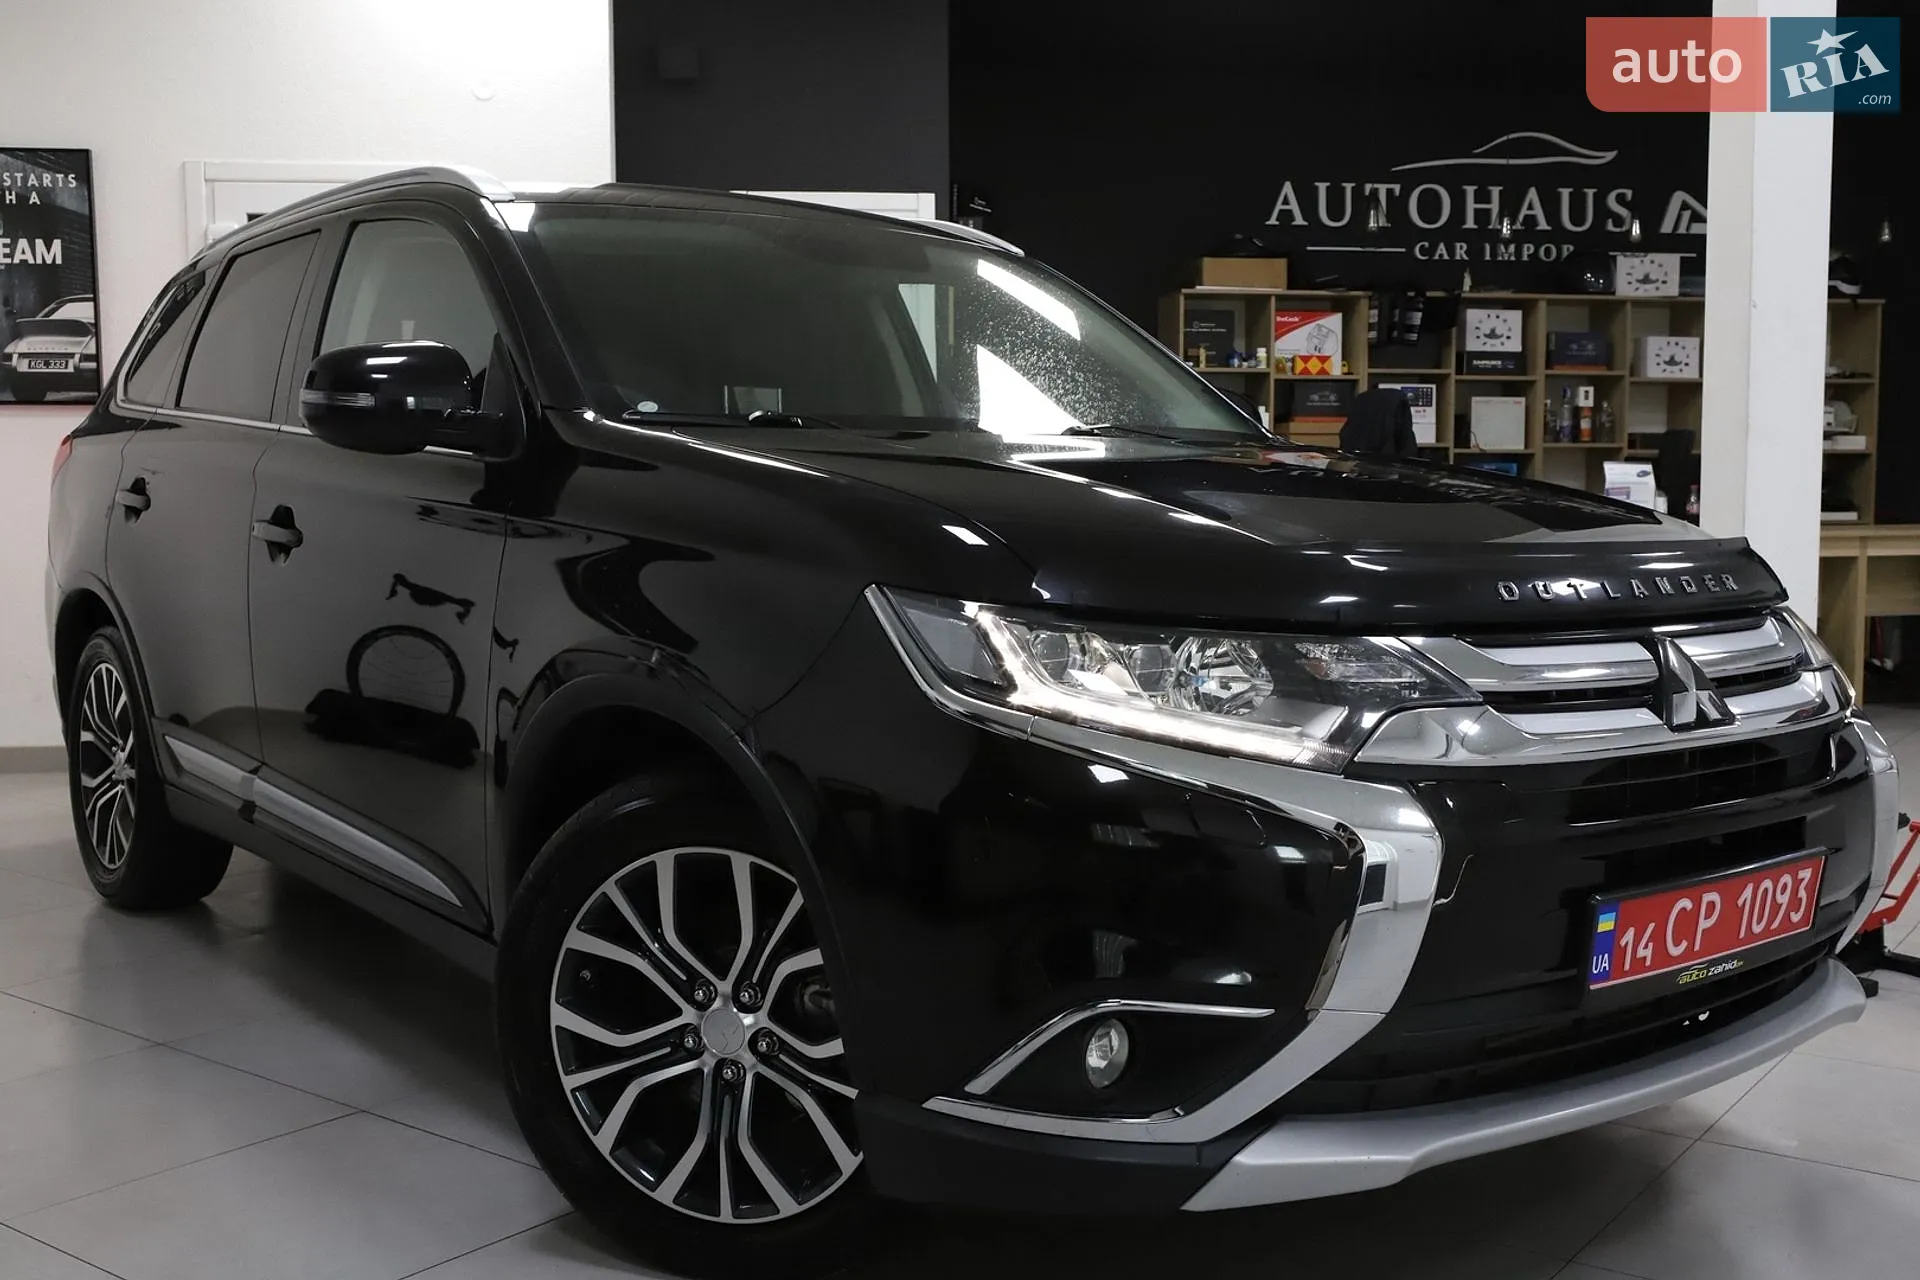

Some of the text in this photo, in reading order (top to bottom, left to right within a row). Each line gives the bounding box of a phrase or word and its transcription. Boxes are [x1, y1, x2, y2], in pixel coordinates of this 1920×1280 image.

[3, 172, 77, 188] STARTS
[29, 191, 41, 205] A
[1265, 180, 1633, 233] AUTOHAUS
[1413, 241, 1576, 263] CAR IMPOR
[30, 360, 66, 369] KGL 333
[1495, 573, 1738, 601] OUTLANDER
[1619, 868, 1813, 972] 14 CP 1093
[1591, 952, 1609, 974] UA
